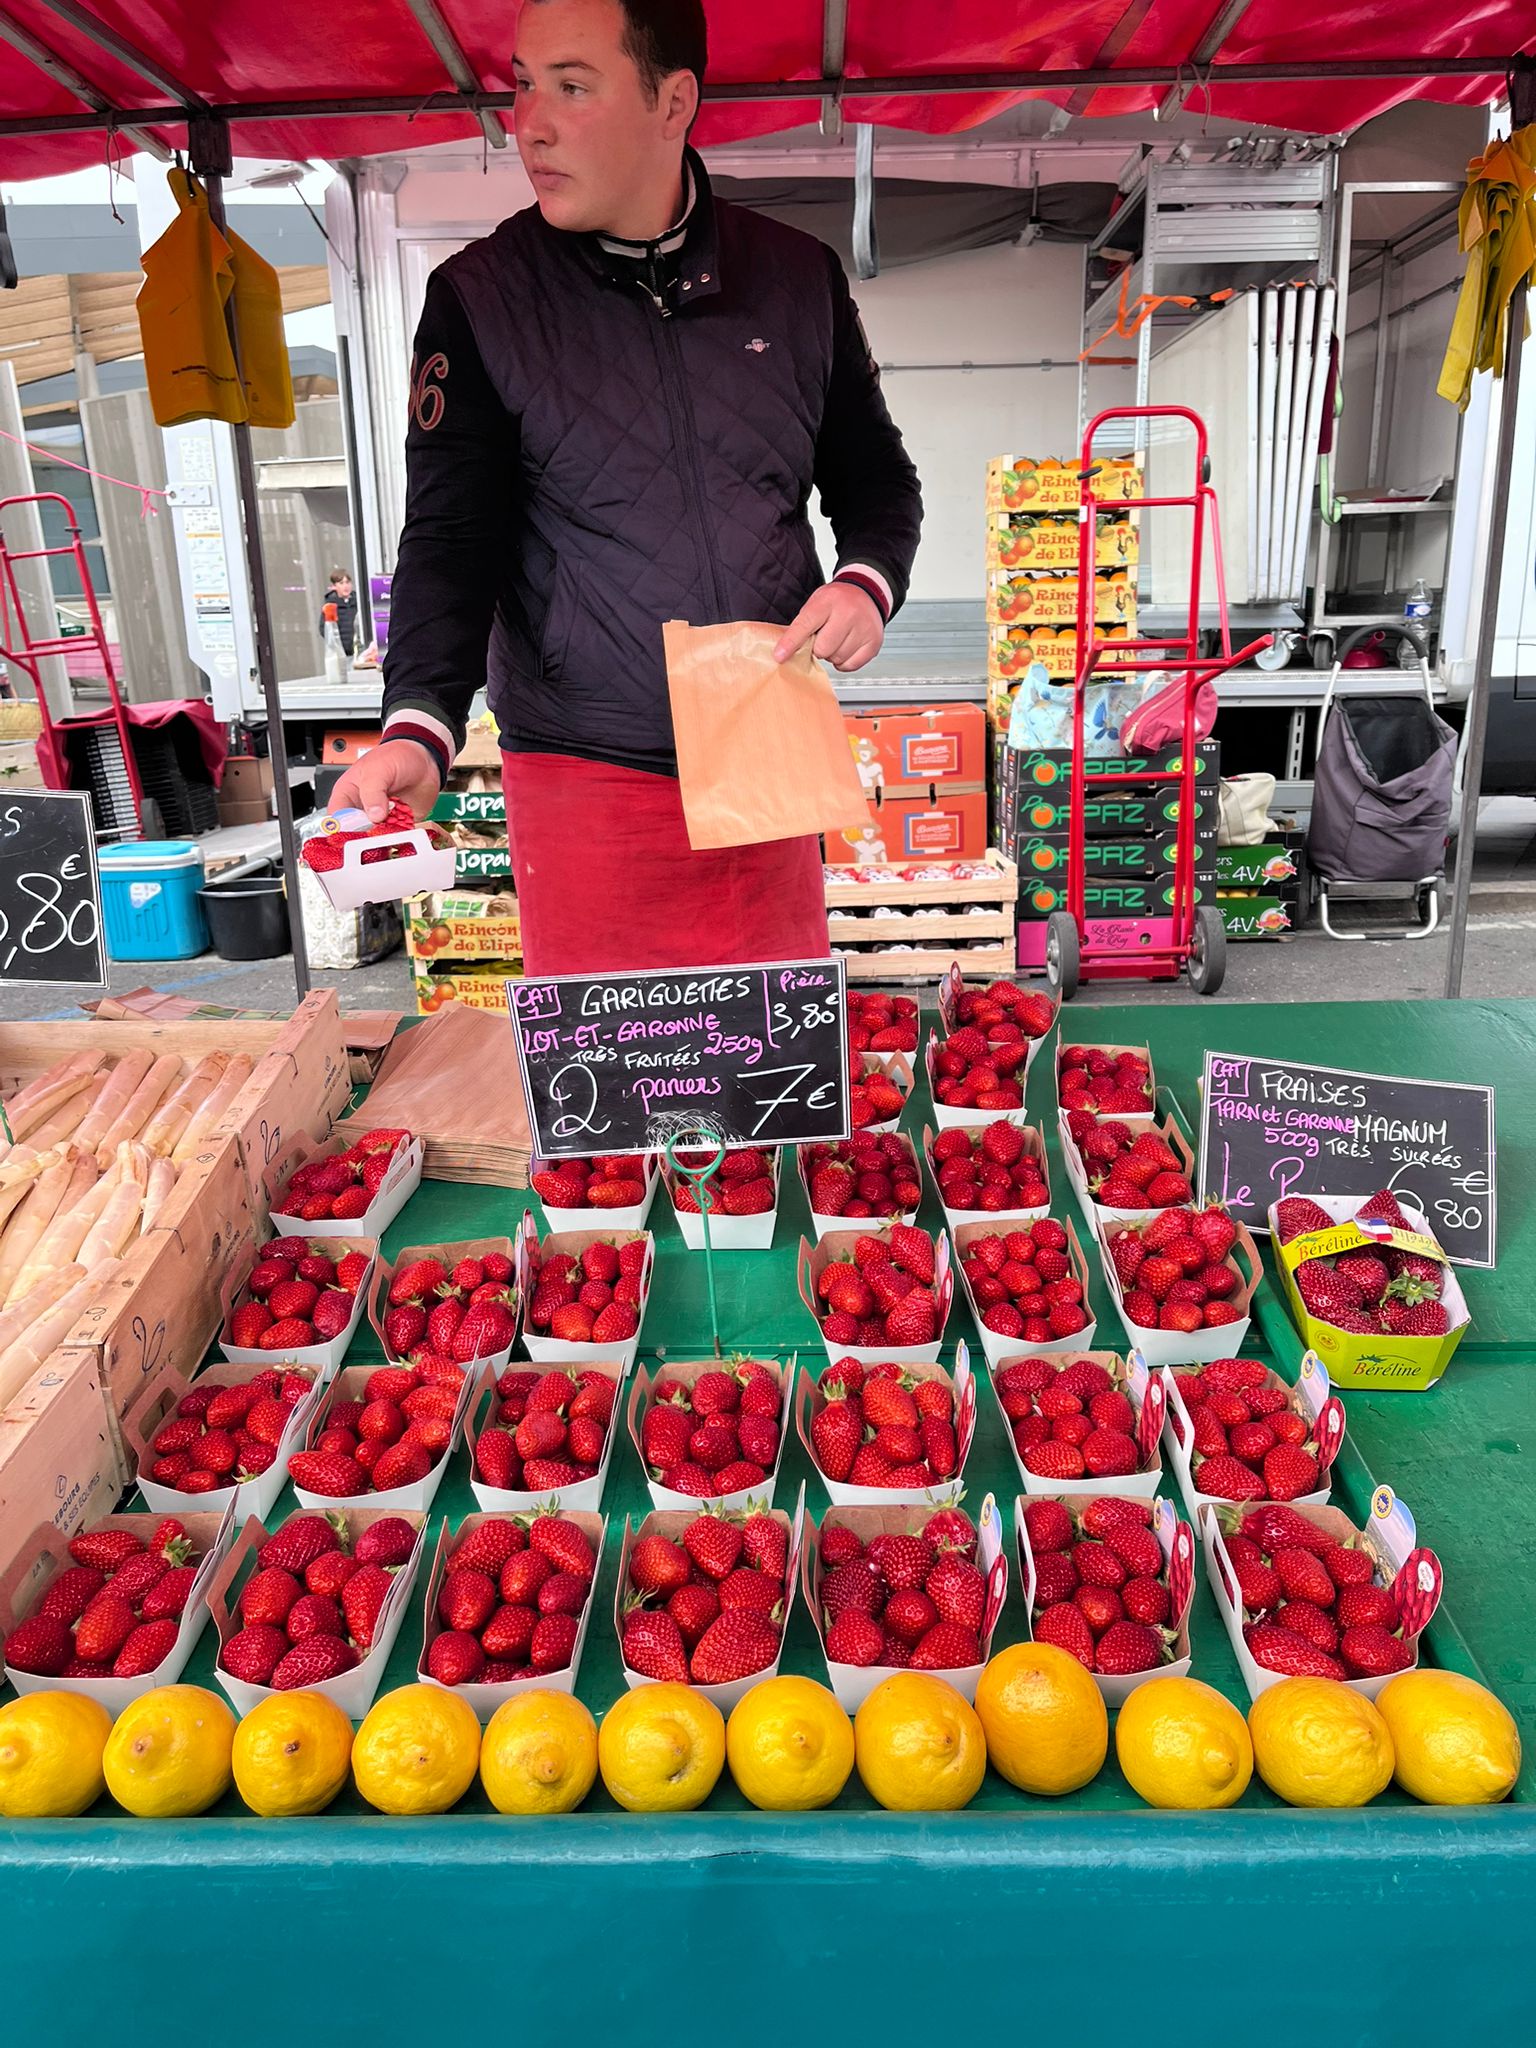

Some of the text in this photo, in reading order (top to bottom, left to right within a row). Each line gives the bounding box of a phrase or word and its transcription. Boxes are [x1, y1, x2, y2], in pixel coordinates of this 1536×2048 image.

[1042, 475, 1101, 487] Rincn
[1040, 491, 1106, 502] de Ele
[1036, 533, 1080, 544] Rinc
[1035, 548, 1055, 560] de
[1036, 589, 1078, 600] Rinc
[1034, 604, 1054, 615] de
[1036, 644, 1077, 655] Rinc
[454, 793, 505, 818] Jopa
[0, 806, 22, 836] S
[1232, 865, 1260, 881] 4V
[0, 873, 98, 969] ,80
[454, 923, 517, 936] Rincón
[1227, 916, 1254, 932] 4V
[454, 939, 475, 951] de
[483, 996, 507, 1008] Eli
[514, 985, 556, 1010] CAT
[581, 976, 751, 1016] GARIGUETTES
[522, 1012, 763, 1064] LOT-ET-GARONNE 250g
[1212, 1060, 1246, 1079] CAT
[1261, 1069, 1367, 1107] FRAISES
[550, 1064, 611, 1138] 2
[737, 1064, 818, 1136] 7
[807, 1082, 837, 1109] €
[1350, 1114, 1448, 1145] MAGNUM
[1264, 1127, 1320, 1157] 500g
[1325, 1138, 1372, 1159] TRÈS
[1214, 1141, 1255, 1207] Le
[1450, 1170, 1494, 1196] €
[1300, 1234, 1363, 1262] Béréline
[1352, 1362, 1422, 1377] Béréline
[51, 1482, 80, 1525] EBOURG
